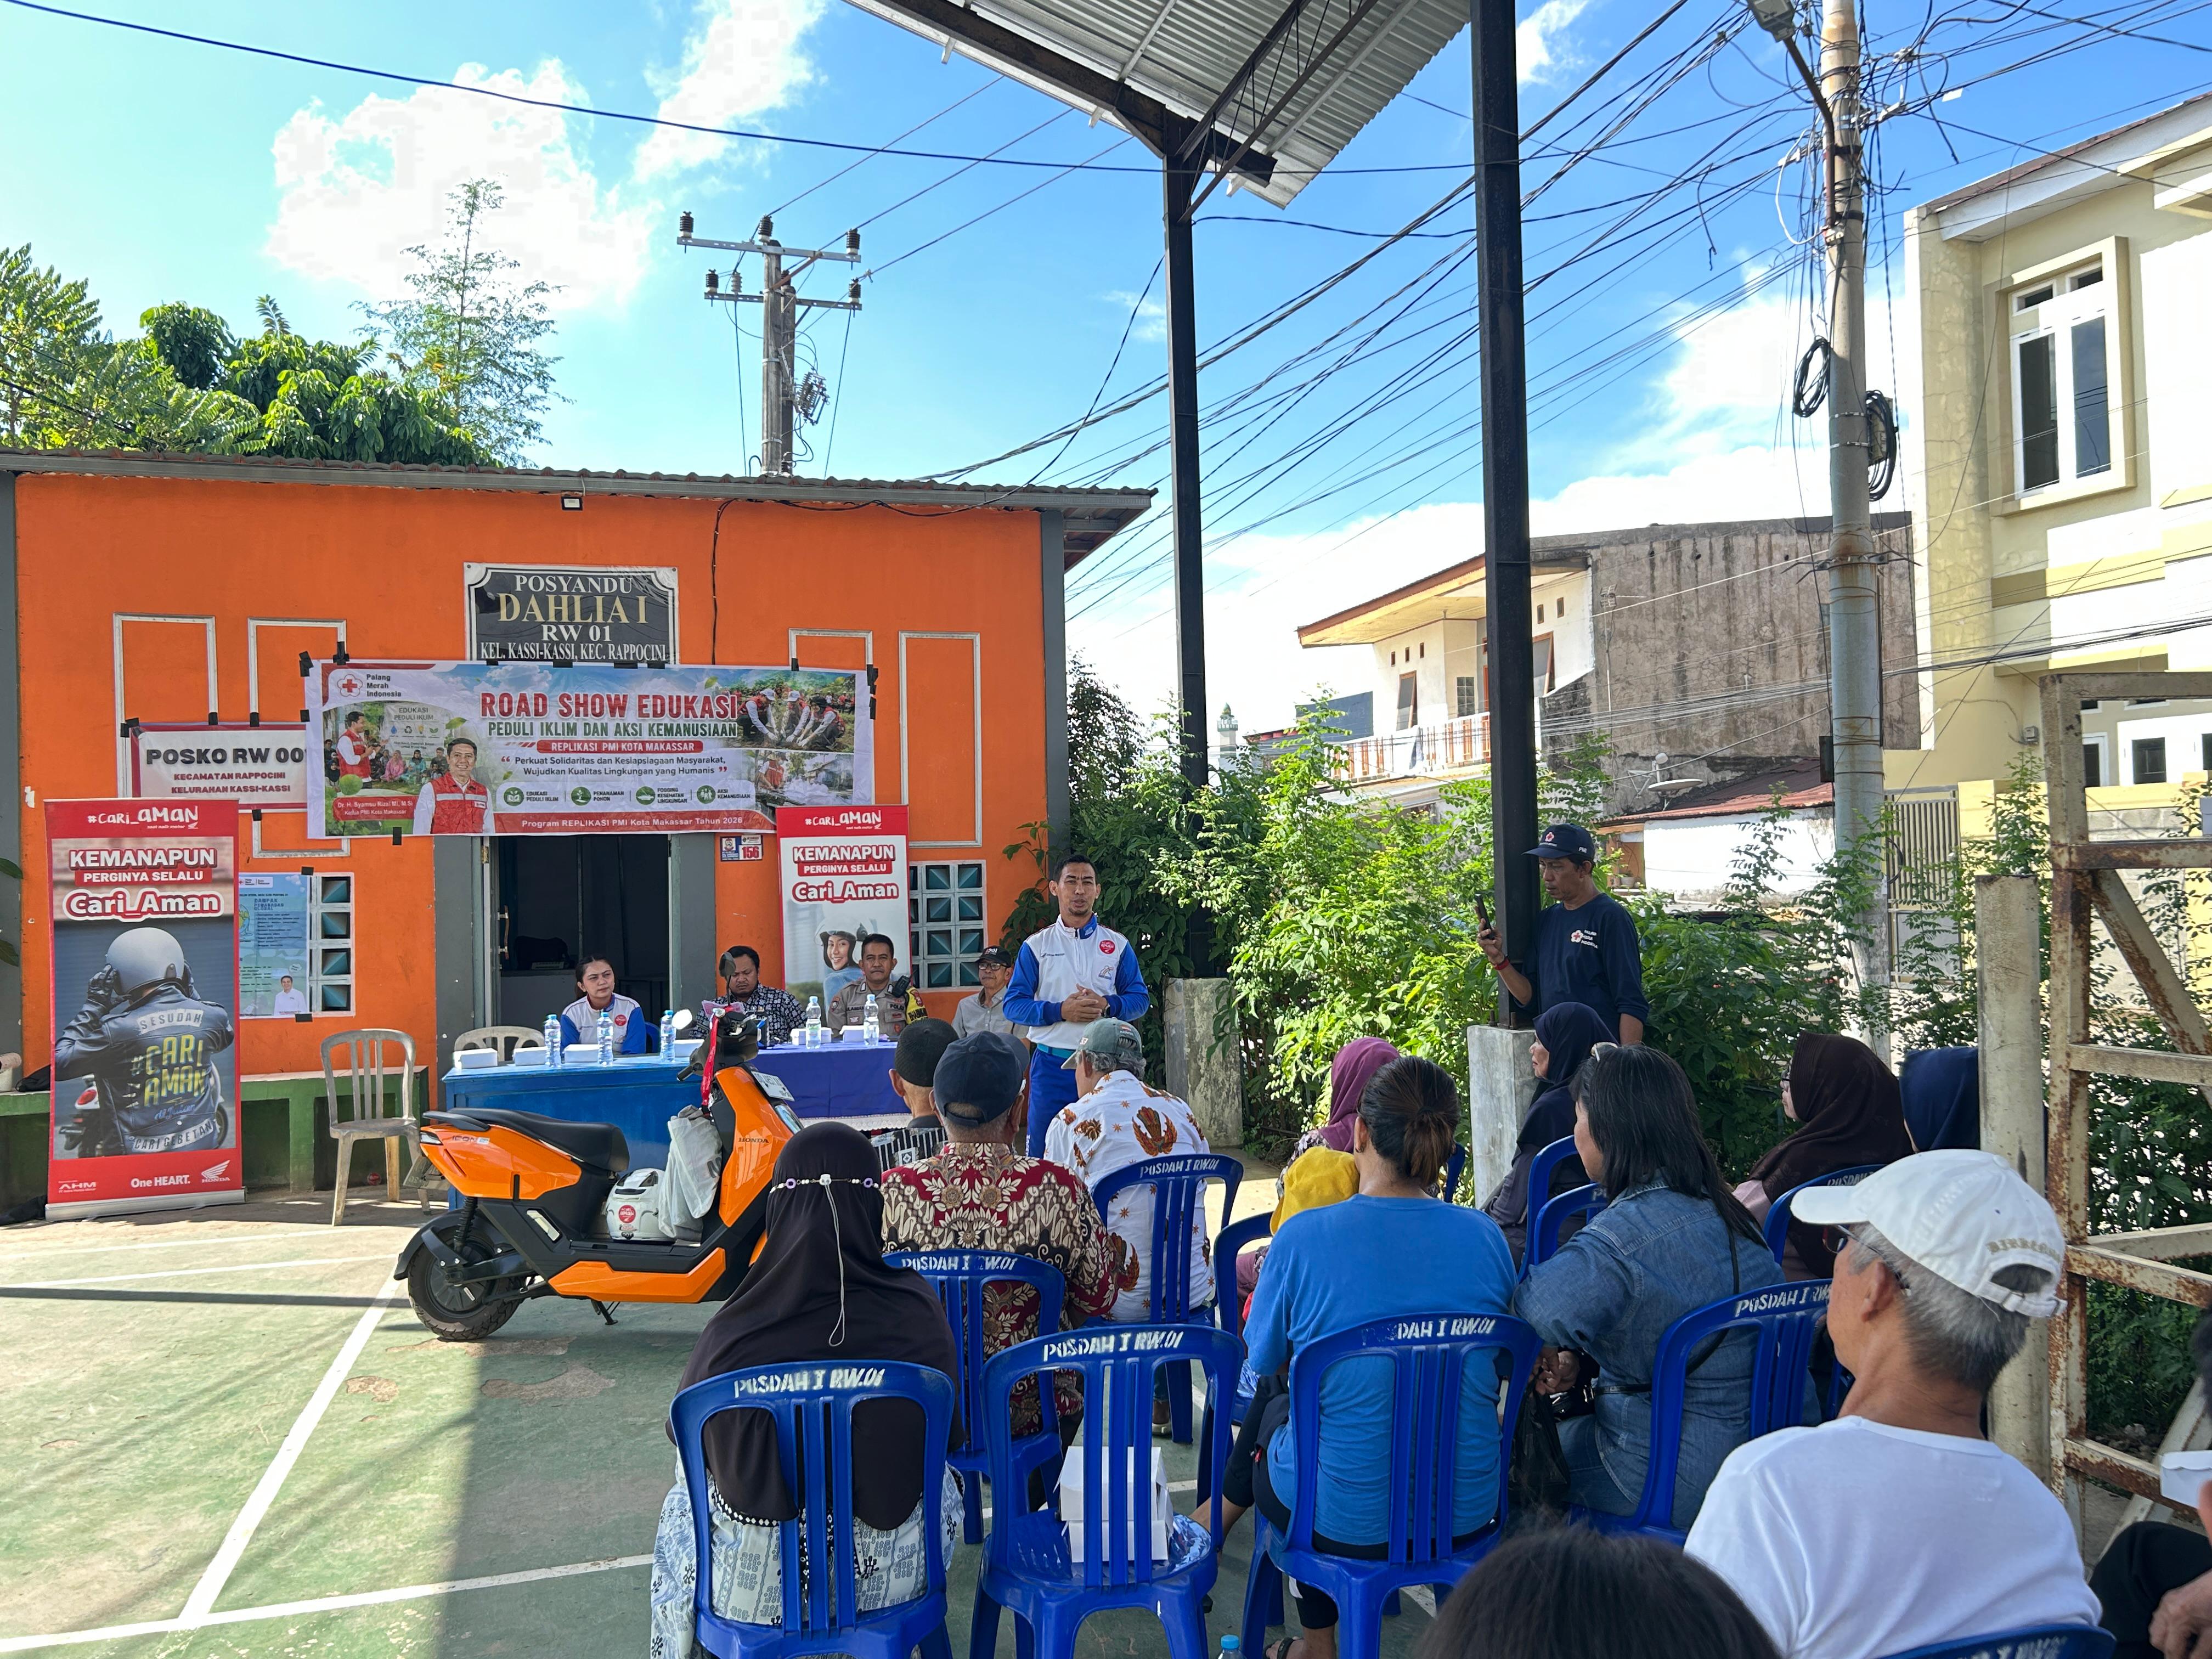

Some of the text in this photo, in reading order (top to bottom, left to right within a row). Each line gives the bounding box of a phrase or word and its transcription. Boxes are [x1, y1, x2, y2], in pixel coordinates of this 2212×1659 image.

[515, 575, 633, 594] POSYANDU
[497, 593, 648, 624] DAHLIA I
[541, 624, 612, 642] RW 01
[481, 642, 667, 661] KEL. KASSI-KASSI, KEC. RAPPOCINI
[481, 692, 737, 719] ROAD SHOW EDUKASI
[489, 722, 737, 736] PEDULI IKLIM DAN AKSI KEMANUSIAAN
[551, 742, 695, 751] REPLIKASI PMI KOTA MAKASSAR
[146, 747, 307, 765] POSKO RW 00
[615, 757, 674, 765] Kesiapsiagaan
[676, 757, 726, 765] Masyarakat,
[523, 768, 566, 776] Wujudkan
[605, 768, 653, 776] Lingkungan
[522, 820, 560, 828] Program
[562, 819, 612, 827] REPLIKASI
[652, 817, 693, 826] Makassar
[69, 849, 216, 868] KEMANAPUN
[742, 846, 760, 859] 156
[793, 845, 894, 861] KEMANAPUN
[83, 871, 204, 883] PERGINYA SELALU
[804, 864, 887, 873] PERGINYA SELALU
[795, 883, 898, 901] Cari_Aman
[70, 893, 219, 916] Cari_Aman
[140, 1013, 203, 1030] SESUDAH
[144, 1065, 207, 1107] AMAN
[135, 1120, 213, 1150] CARI GEBETAN
[1140, 1160, 1184, 1178] POSDAH
[131, 1175, 191, 1188] One HEART.
[901, 1255, 959, 1272] POSDAH
[1735, 1290, 1798, 1317] POSDAH
[1043, 1335, 1115, 1362] POSDAH
[1135, 1330, 1184, 1350] RW.01
[733, 1371, 809, 1398] POSDAH
[830, 1368, 886, 1389] RW.01
